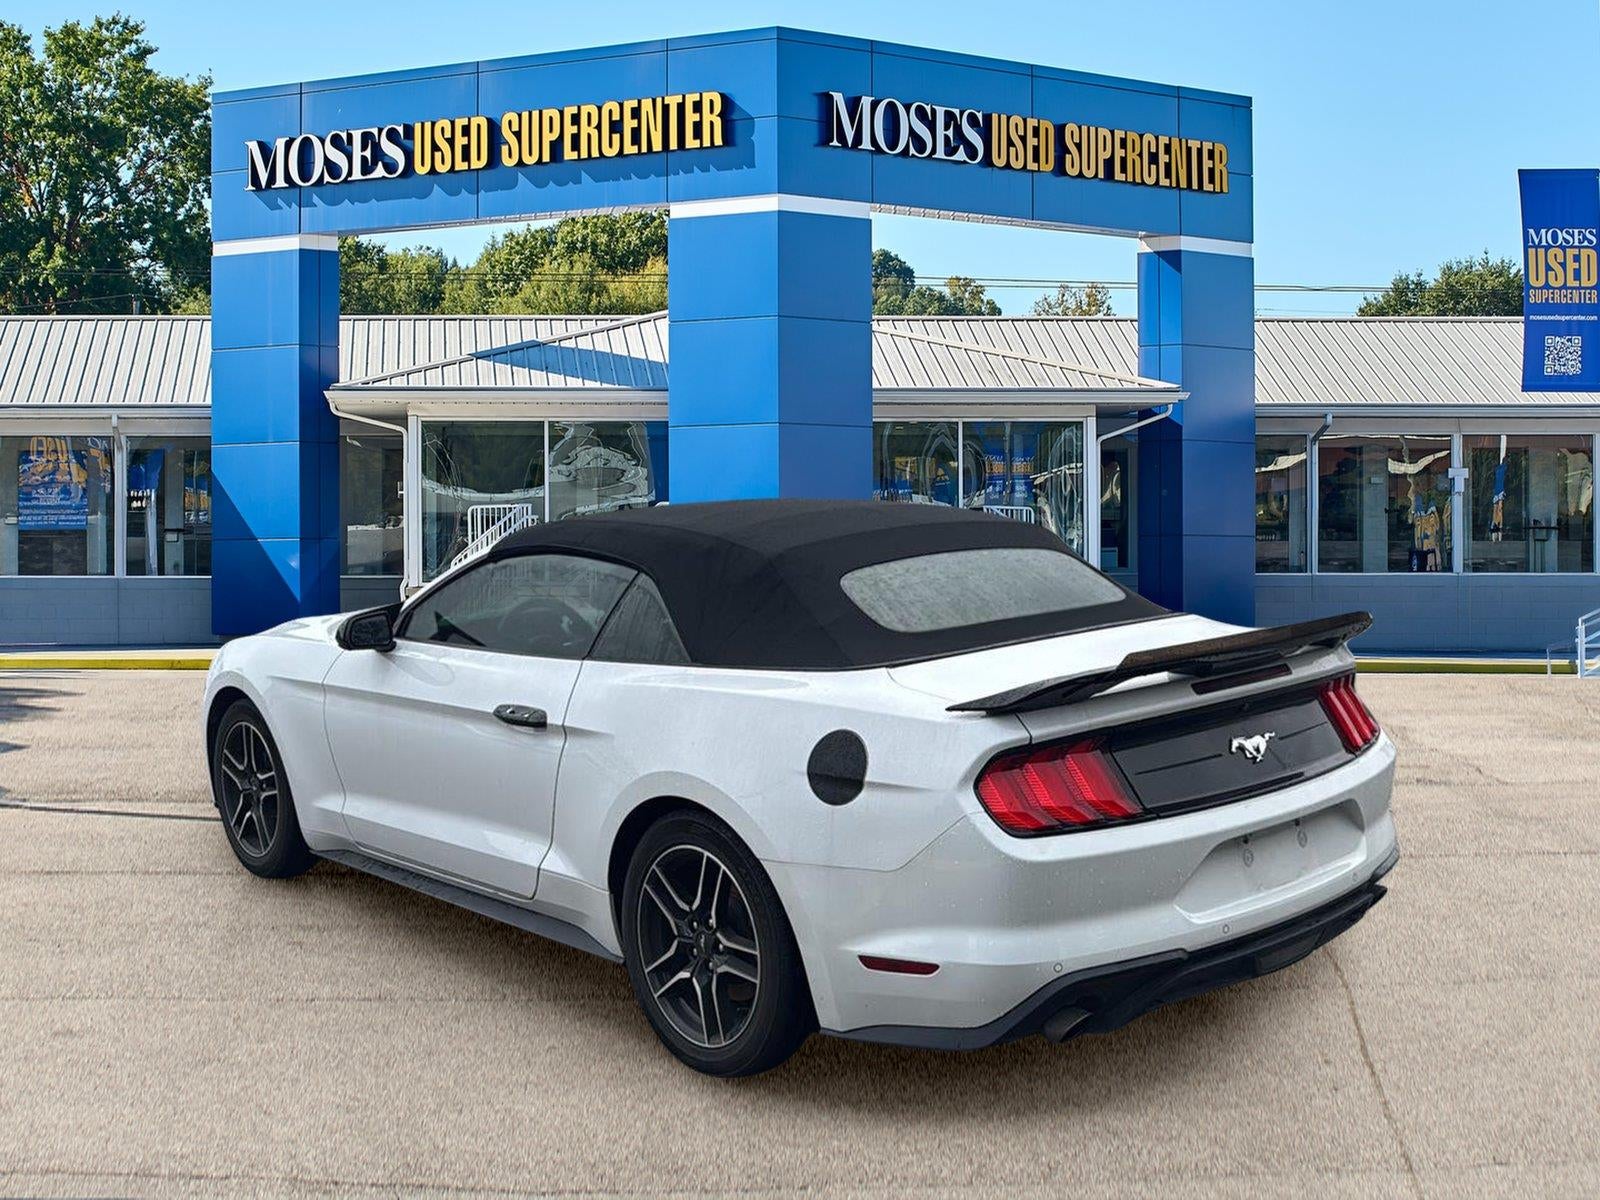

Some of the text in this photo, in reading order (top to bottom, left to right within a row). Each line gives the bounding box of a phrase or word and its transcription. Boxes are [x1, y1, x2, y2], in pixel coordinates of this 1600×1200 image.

[244, 91, 724, 192] MOSES USED SUPERCENTER
[828, 91, 1229, 194] MOSES USED SUPERCENTER
[1527, 228, 1597, 247] MOSES
[1528, 248, 1598, 286] USED
[1529, 289, 1598, 304] SUPERCENTER
[1529, 314, 1598, 322] mosesusedsupercenter.com
